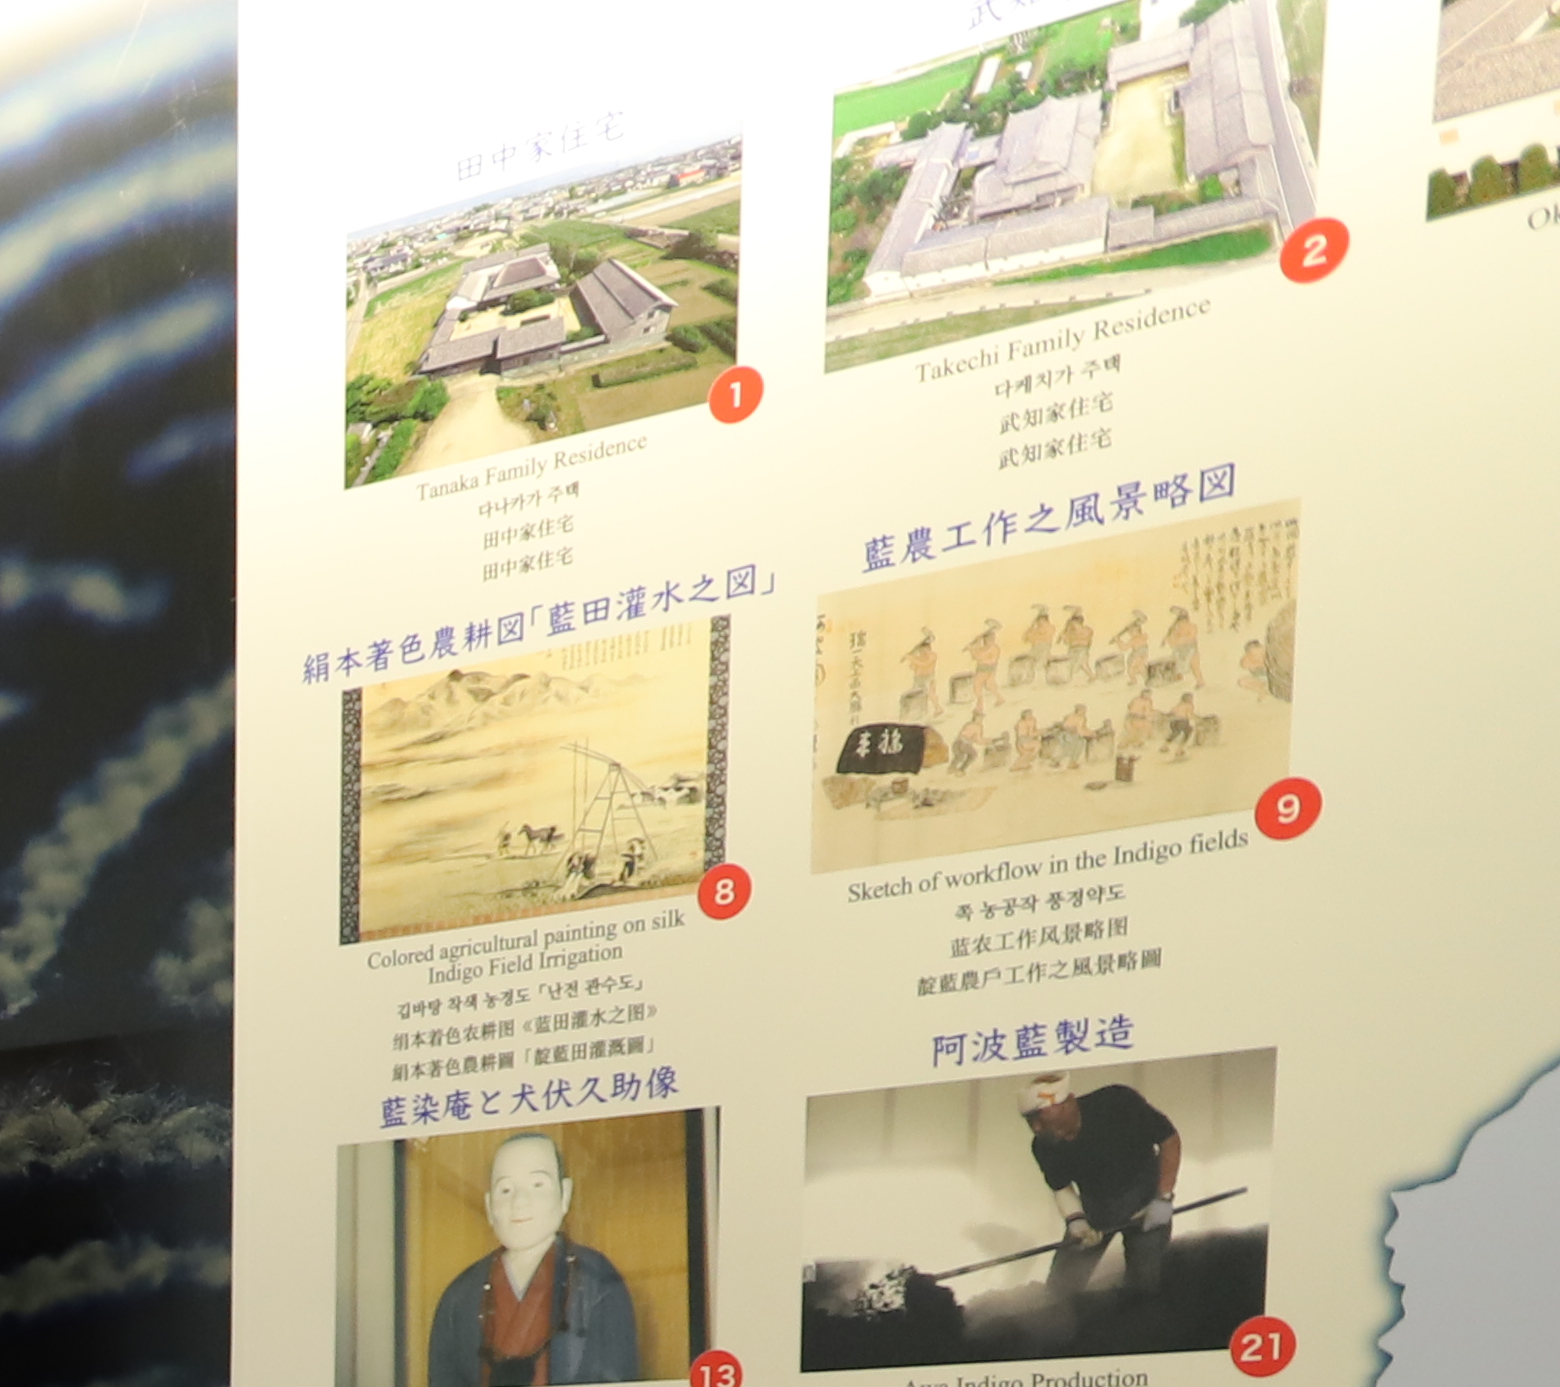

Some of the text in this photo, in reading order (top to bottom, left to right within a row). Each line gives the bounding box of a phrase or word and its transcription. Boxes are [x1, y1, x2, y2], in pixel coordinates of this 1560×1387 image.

[457, 111, 624, 181] 田中家住宅
[1302, 235, 1327, 268] 2
[915, 298, 1212, 384] Takechi Family Residence
[729, 382, 741, 408] 1
[994, 353, 1122, 399] 다케치가 주택
[999, 390, 1115, 435] 武知家住宅
[417, 434, 648, 501] Tanaka Family Residence
[998, 427, 1113, 471] 武知家住宅
[478, 490, 542, 519] 다나카가
[861, 462, 1237, 574] 藍農工作之風景略図
[483, 514, 574, 550] 田中家住宅
[483, 546, 574, 582] 田中家住宅
[301, 563, 776, 685] 絹本著色農耕図「藍田灌水之図」
[1276, 794, 1301, 823] 9
[847, 829, 1249, 903] Sketch of workflow in the Indigo fields
[714, 879, 735, 905] 8
[367, 909, 686, 971] Colored agricultural painting on silk
[949, 916, 1129, 959] 蓝农工作风景略图
[427, 945, 624, 986] Indigo Field Irrigation
[932, 1013, 1135, 1068] 阿波藍製造
[379, 1064, 681, 1130] 藍染庵と犬伏久助像
[1240, 1332, 1282, 1362] 21
